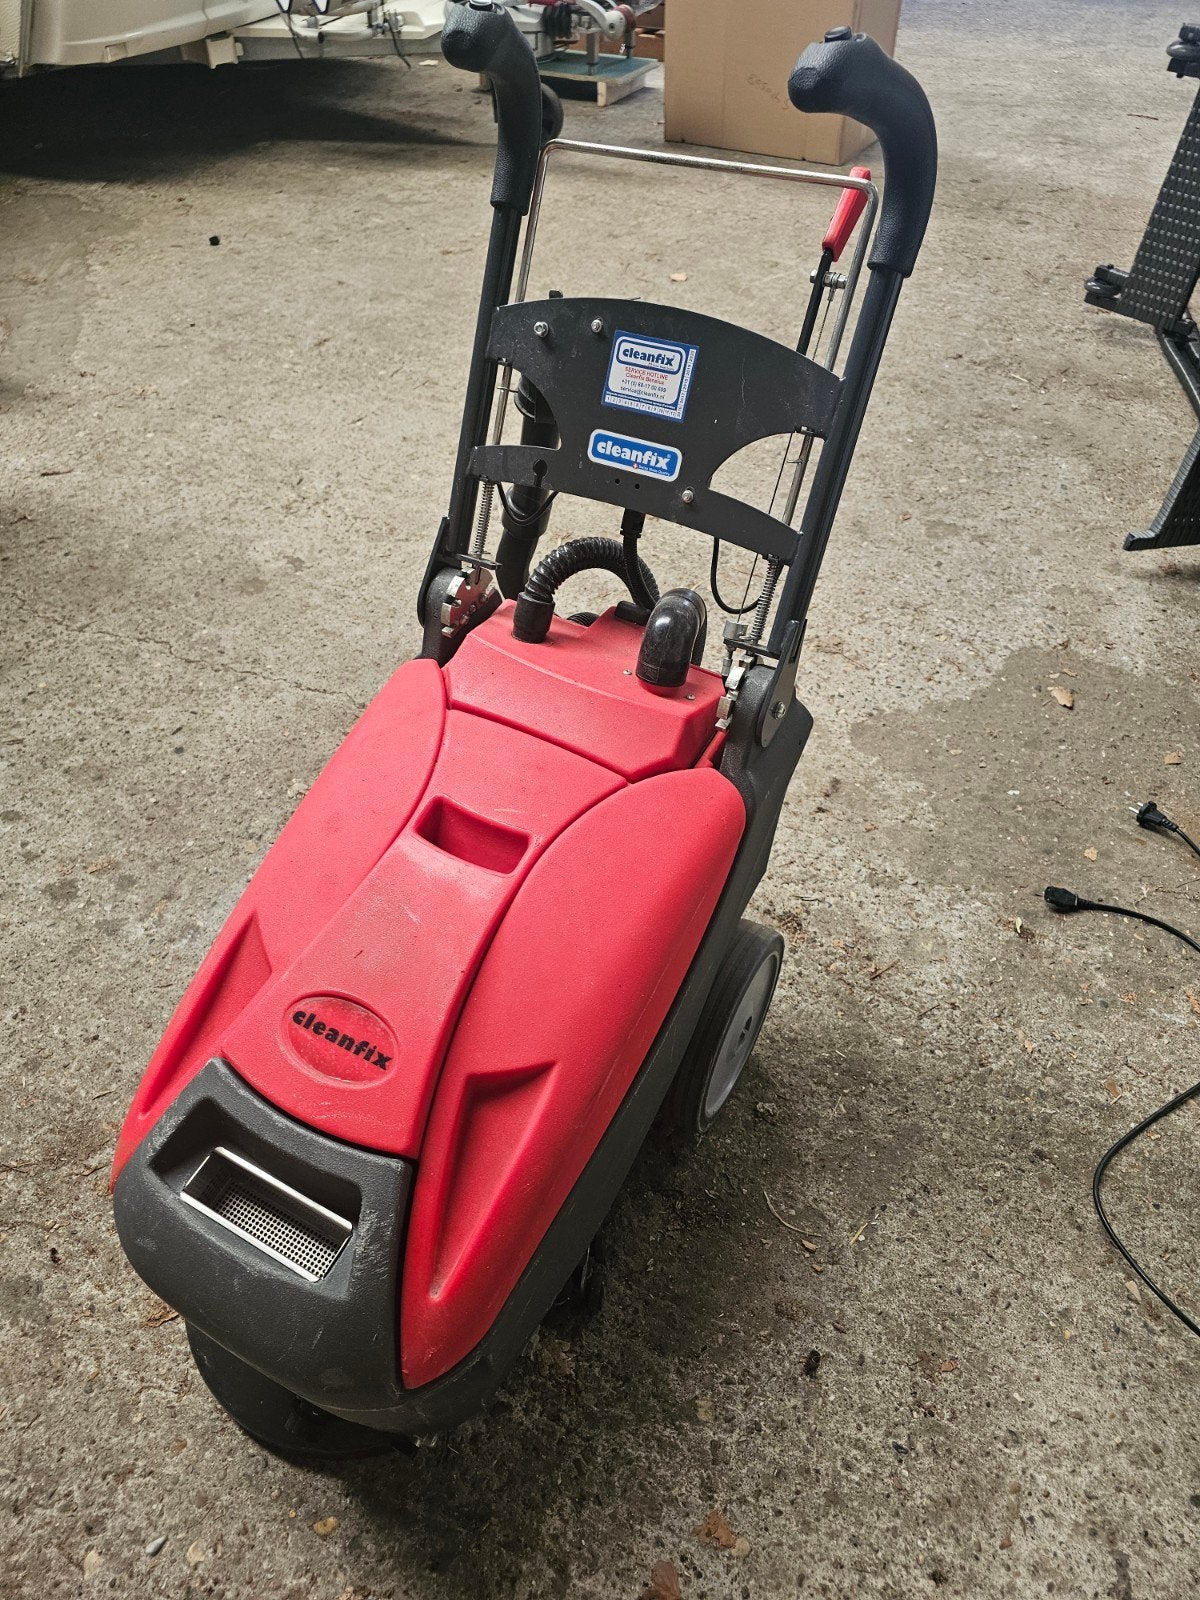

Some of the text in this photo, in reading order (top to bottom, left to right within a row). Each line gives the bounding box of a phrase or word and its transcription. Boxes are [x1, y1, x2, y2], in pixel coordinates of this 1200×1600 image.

[622, 347, 675, 367] cleanfix
[625, 366, 646, 376] SERVICE
[646, 371, 668, 380] HOTLINE
[596, 440, 671, 470] cleanfix
[292, 1010, 393, 1071] cleanfix
